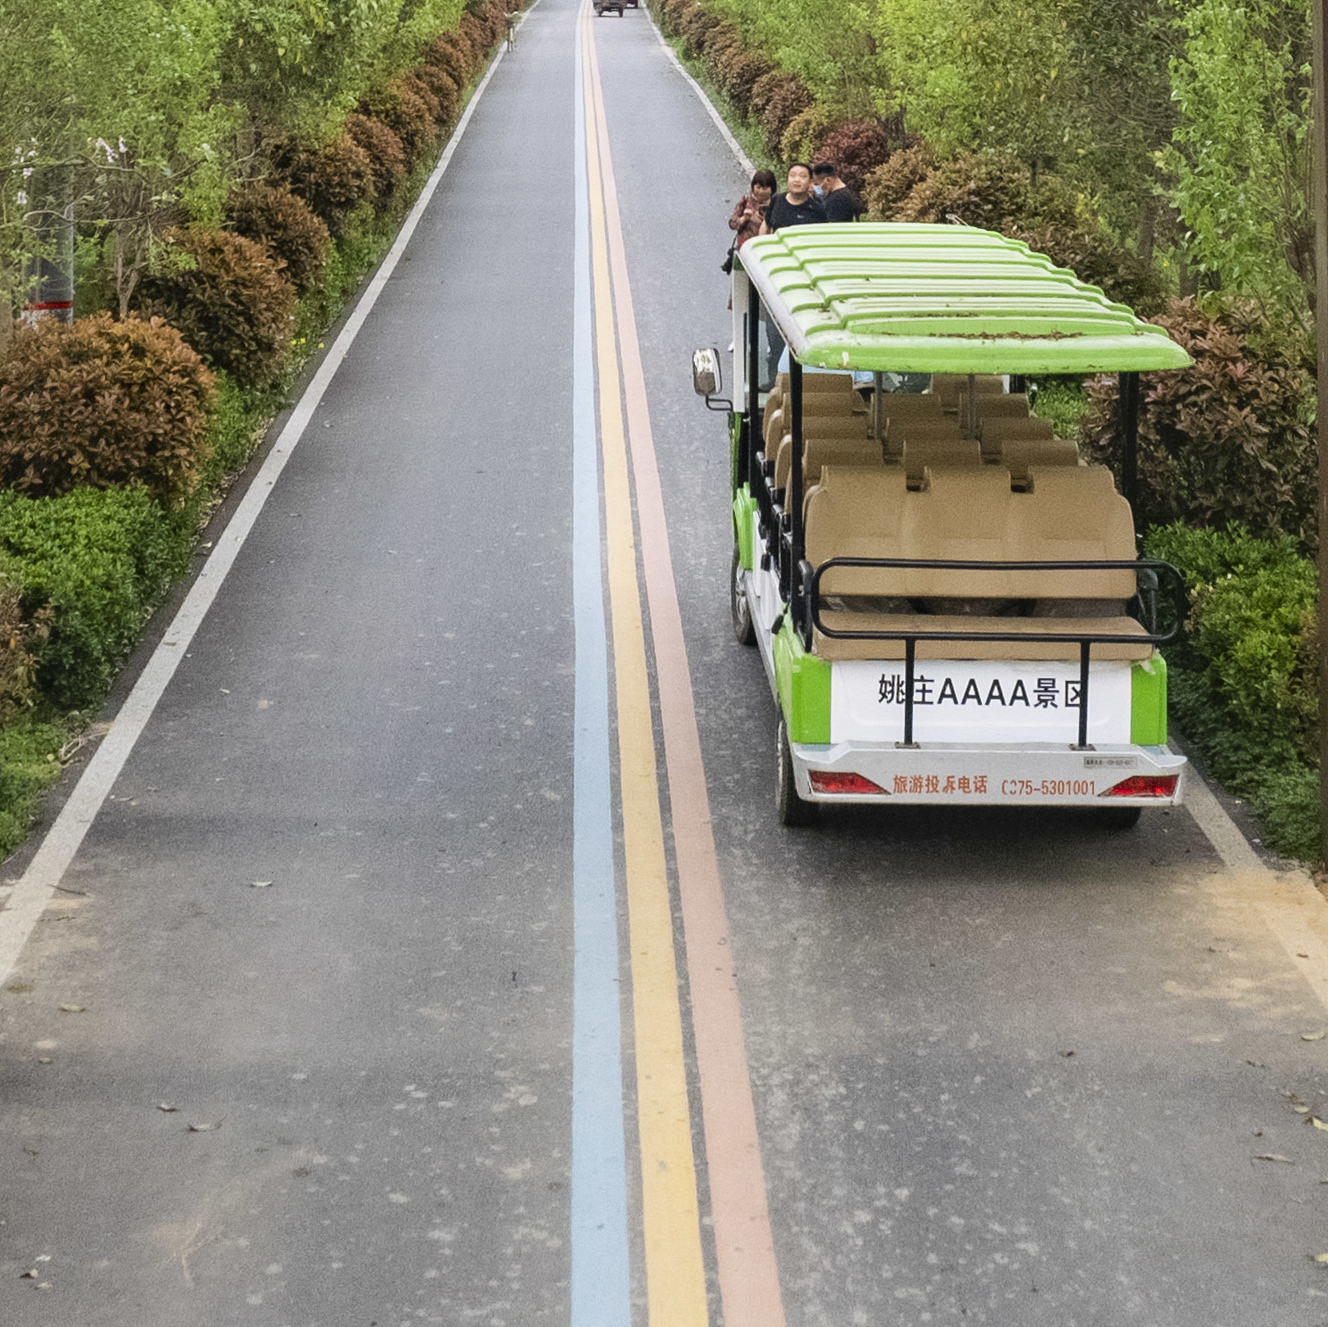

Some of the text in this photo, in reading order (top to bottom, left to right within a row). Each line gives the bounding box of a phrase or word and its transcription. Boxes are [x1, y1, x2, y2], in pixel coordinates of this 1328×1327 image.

[878, 673, 1081, 709] 姚庄AAAA景区
[893, 775, 988, 794] 旅游投诉电话
